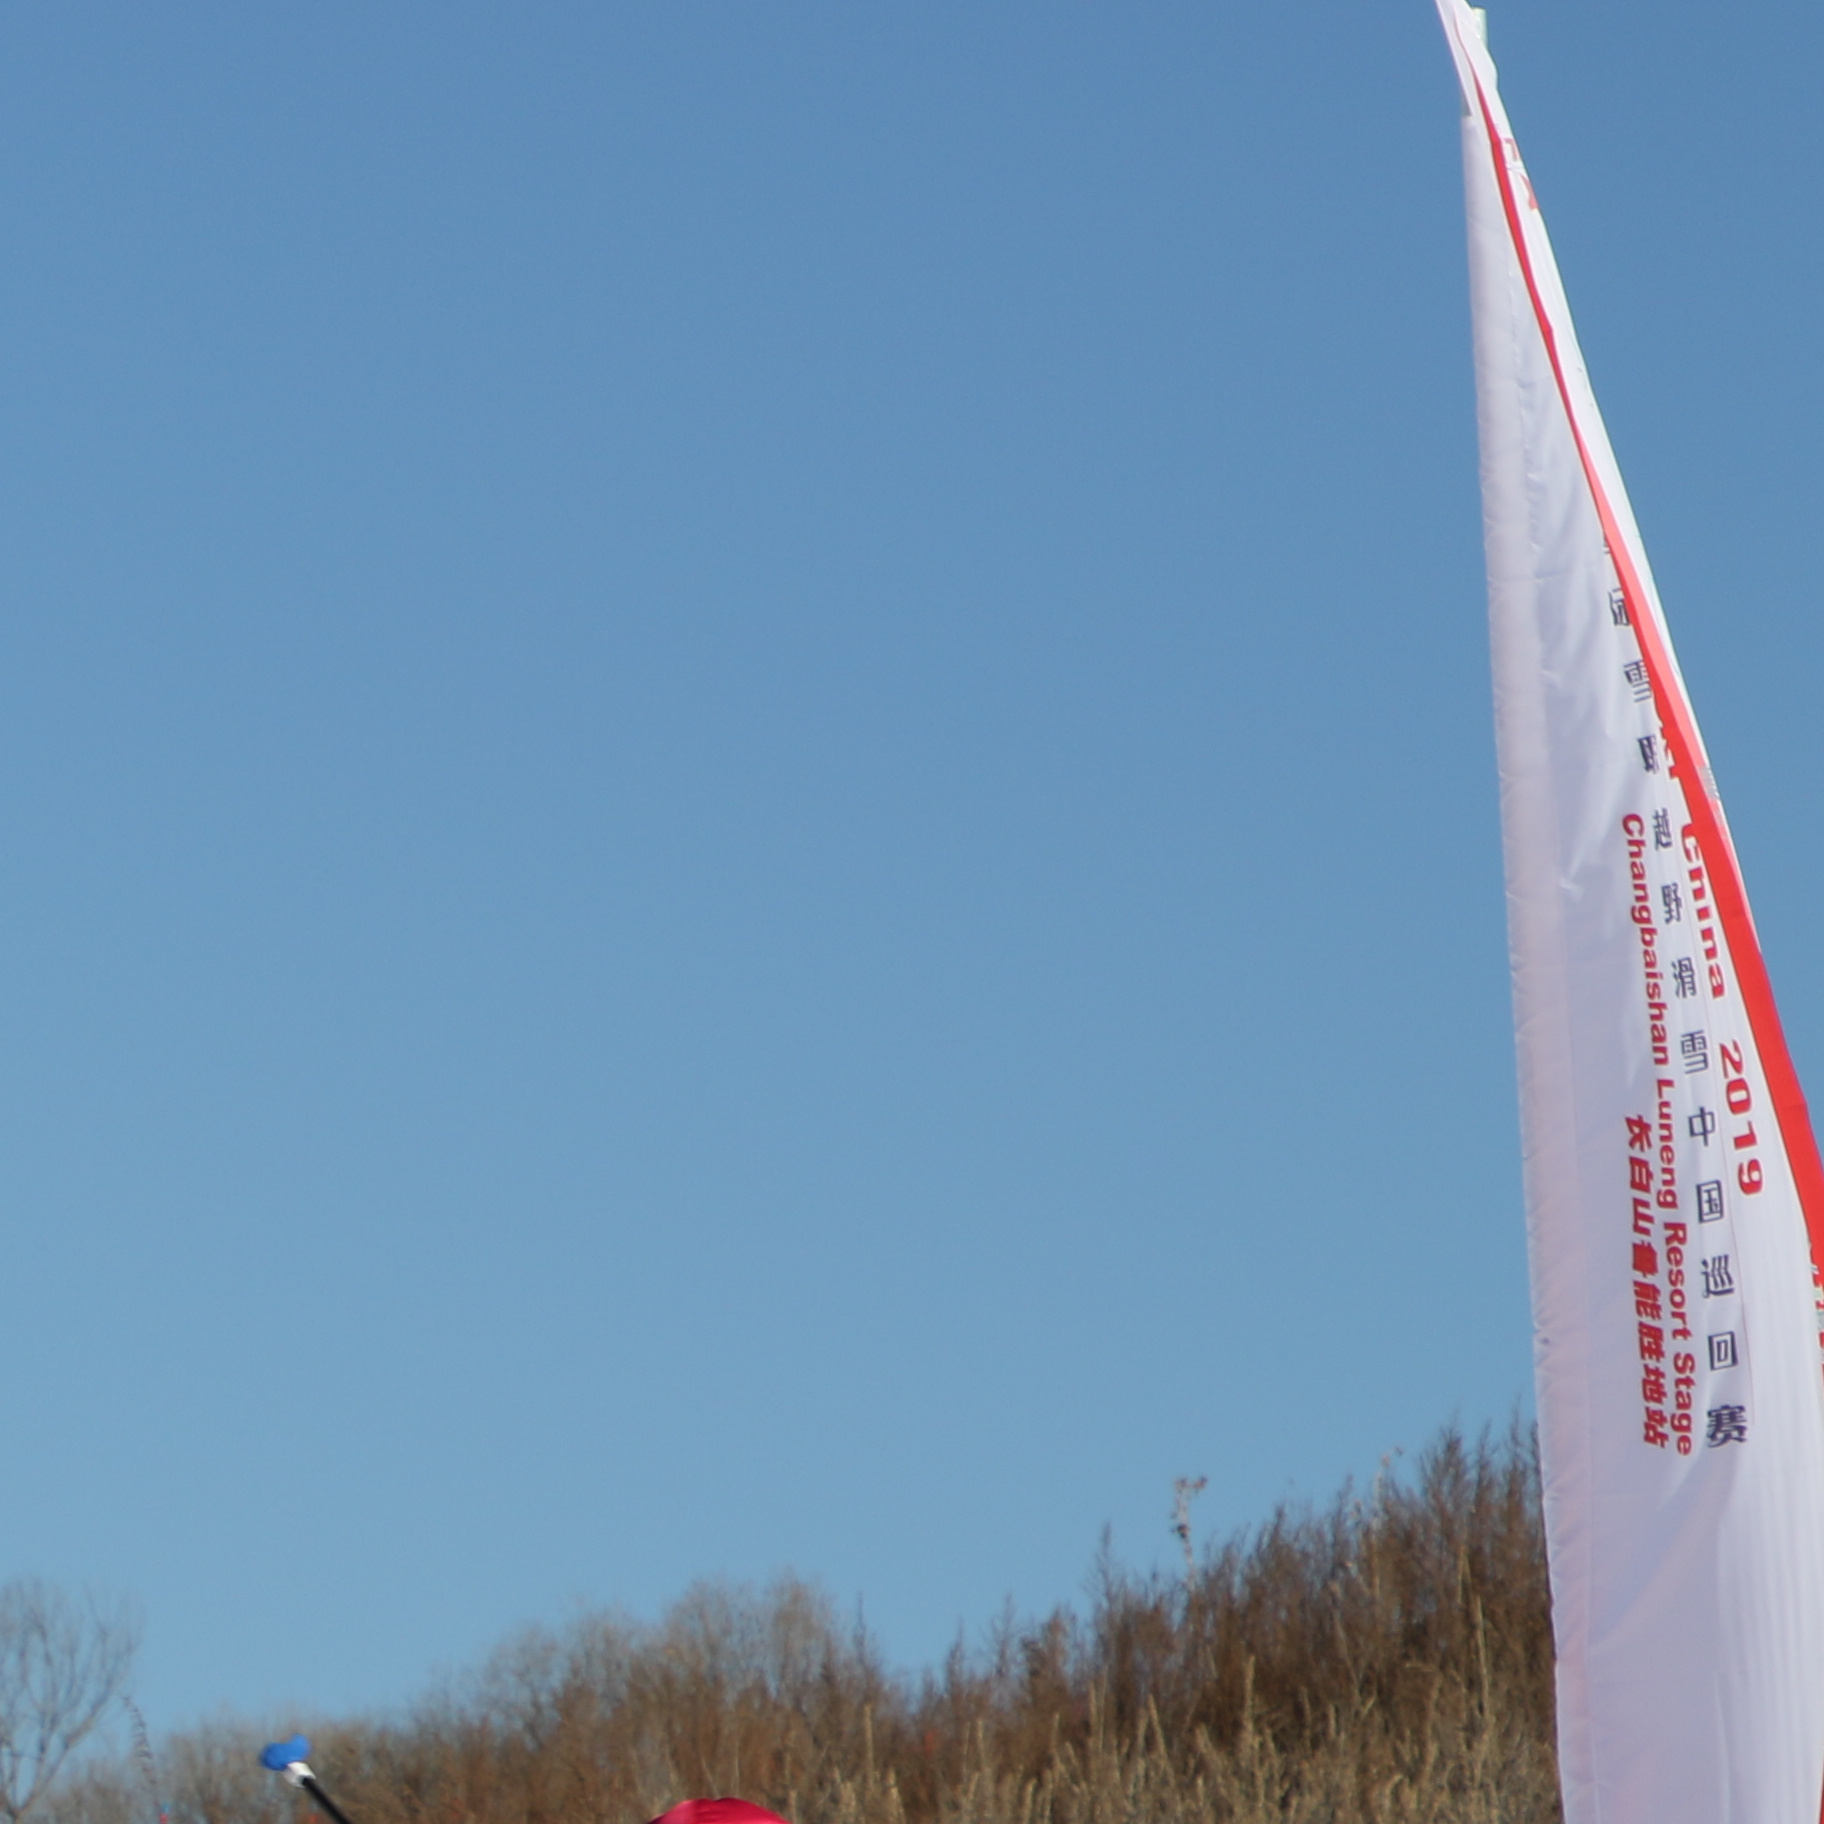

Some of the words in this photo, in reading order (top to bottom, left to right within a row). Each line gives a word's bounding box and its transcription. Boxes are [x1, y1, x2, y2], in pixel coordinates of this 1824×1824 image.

[1621, 812, 1669, 1066] Changbaishan
[1680, 823, 1726, 999] China
[1718, 1039, 1765, 1195] 2019
[1655, 1078, 1679, 1211] Luneng
[1625, 1113, 1670, 1449] 长白山鲁能胜地站
[1663, 1222, 1692, 1341] Resort
[1673, 1353, 1696, 1456] Stage
